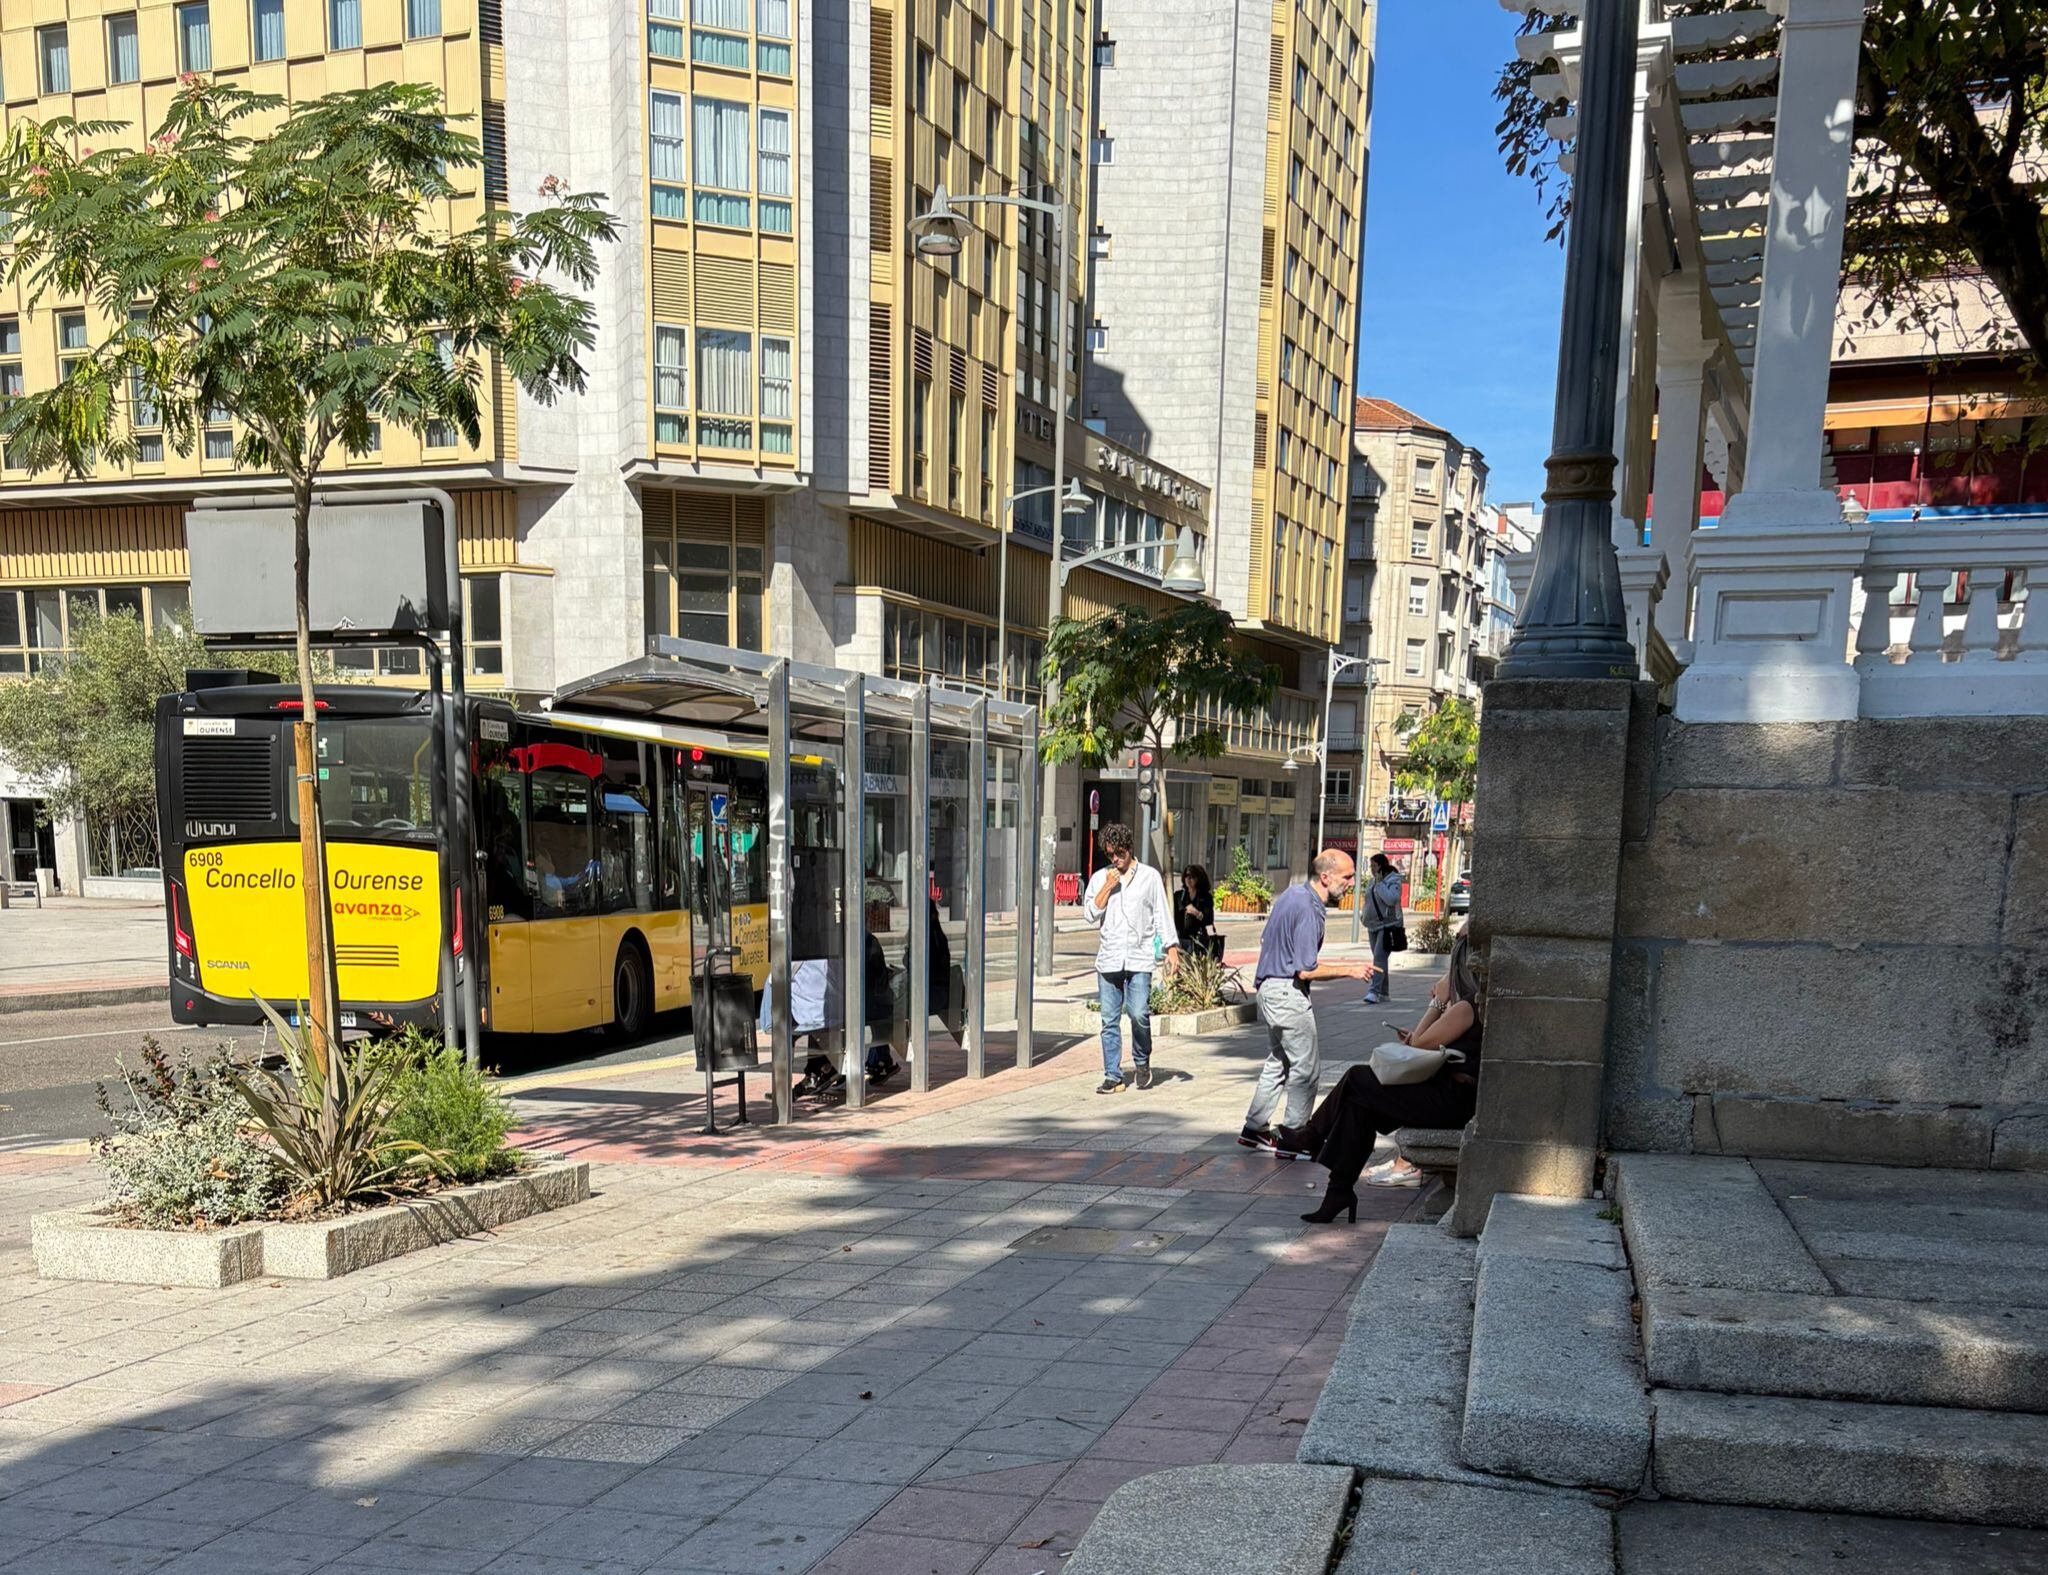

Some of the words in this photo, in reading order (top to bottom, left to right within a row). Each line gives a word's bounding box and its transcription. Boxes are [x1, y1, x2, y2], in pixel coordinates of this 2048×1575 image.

[864, 775, 898, 792] ABANCA
[189, 851, 223, 867] 6908
[206, 868, 296, 889] Concello
[334, 869, 423, 890] Ourense
[334, 902, 402, 915] avanza
[207, 960, 251, 970] SCANIA
